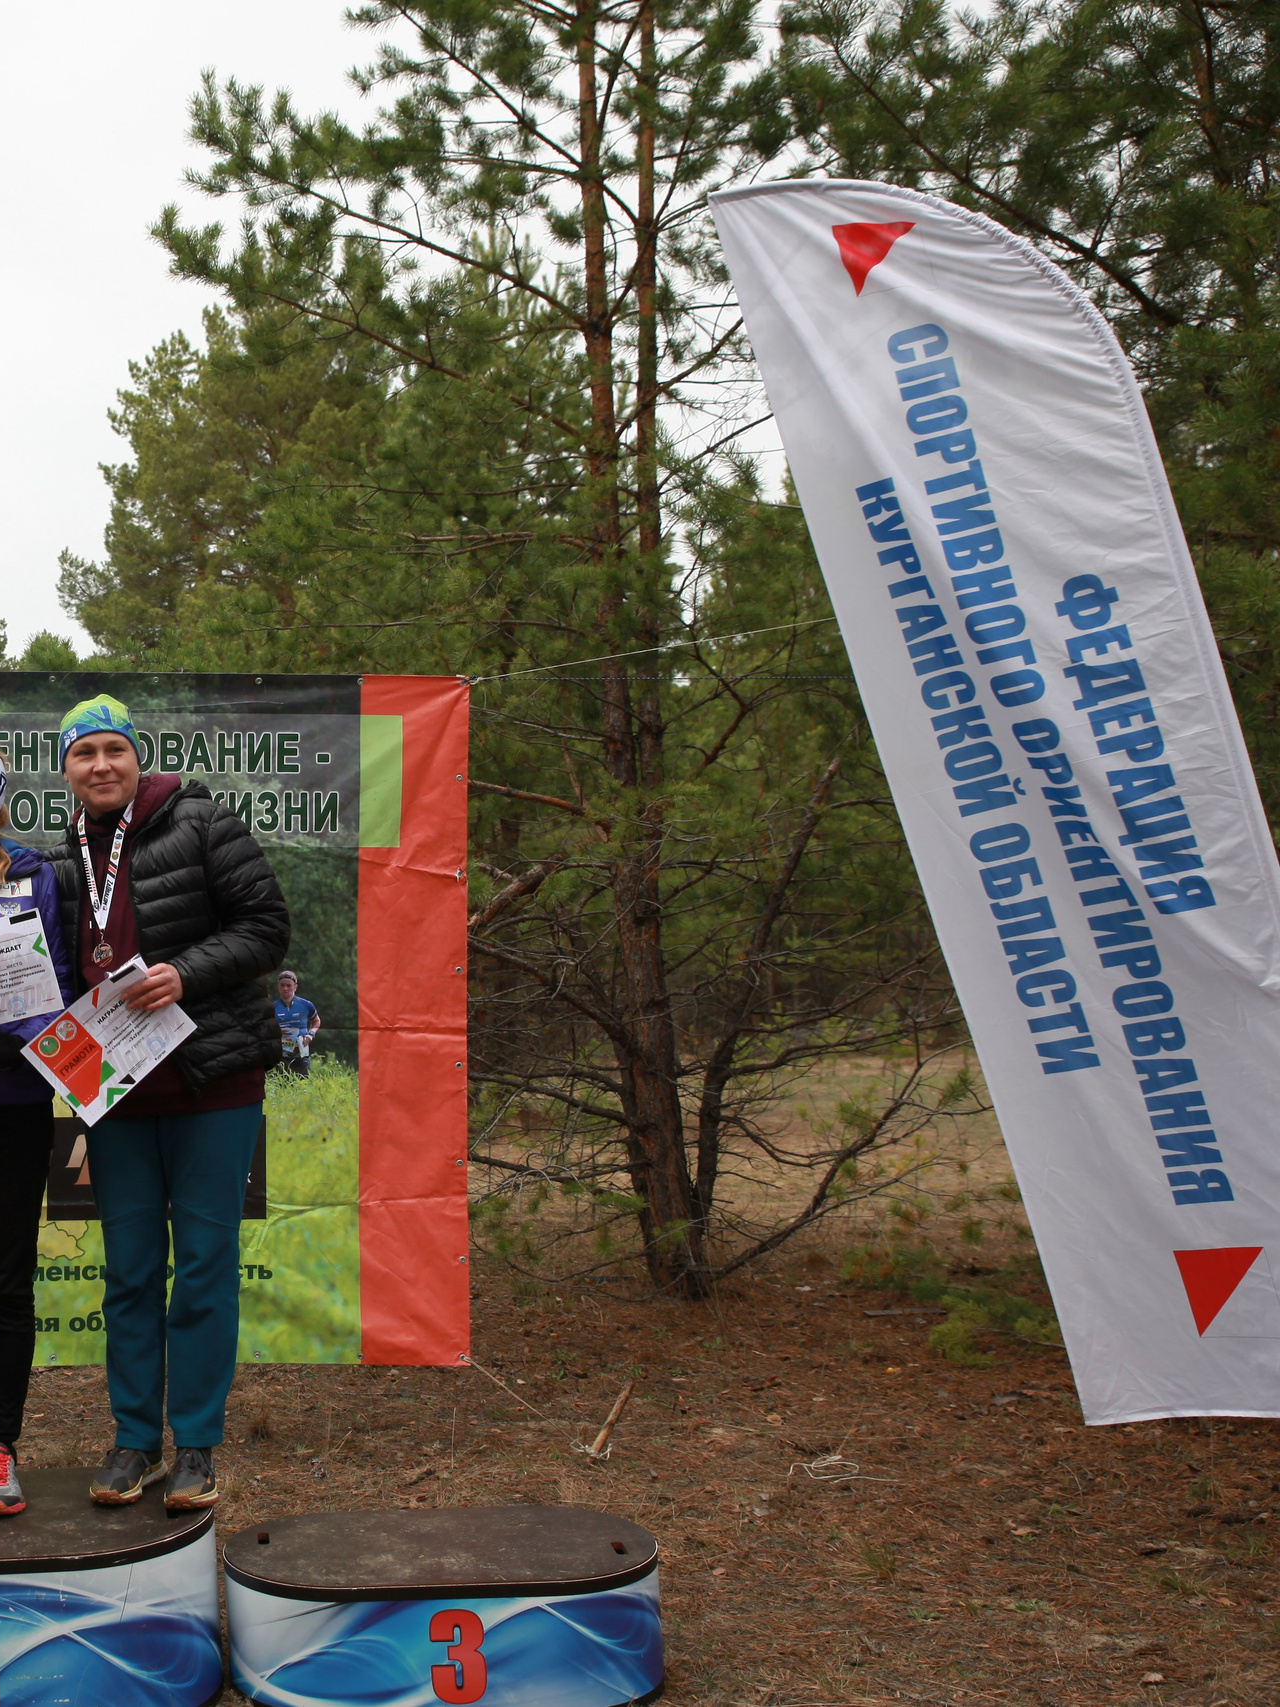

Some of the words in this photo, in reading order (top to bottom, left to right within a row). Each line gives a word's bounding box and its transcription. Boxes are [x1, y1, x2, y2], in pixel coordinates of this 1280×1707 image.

[855, 477, 1026, 817] КУРГАНСКОЙ
[969, 822, 1101, 1074] ОБЛАСТИ
[887, 323, 1045, 708] СПОРТИВНОГО
[1012, 717, 1234, 1205] ОРИЕНТИРОВАНИЯ
[1054, 574, 1216, 915] ФЕДЕРАЦИЯ
[59, 1043, 96, 1077] ГРАМОТА
[95, 997, 128, 1025] НАГРАЖД
[429, 1608, 488, 1705] 3
